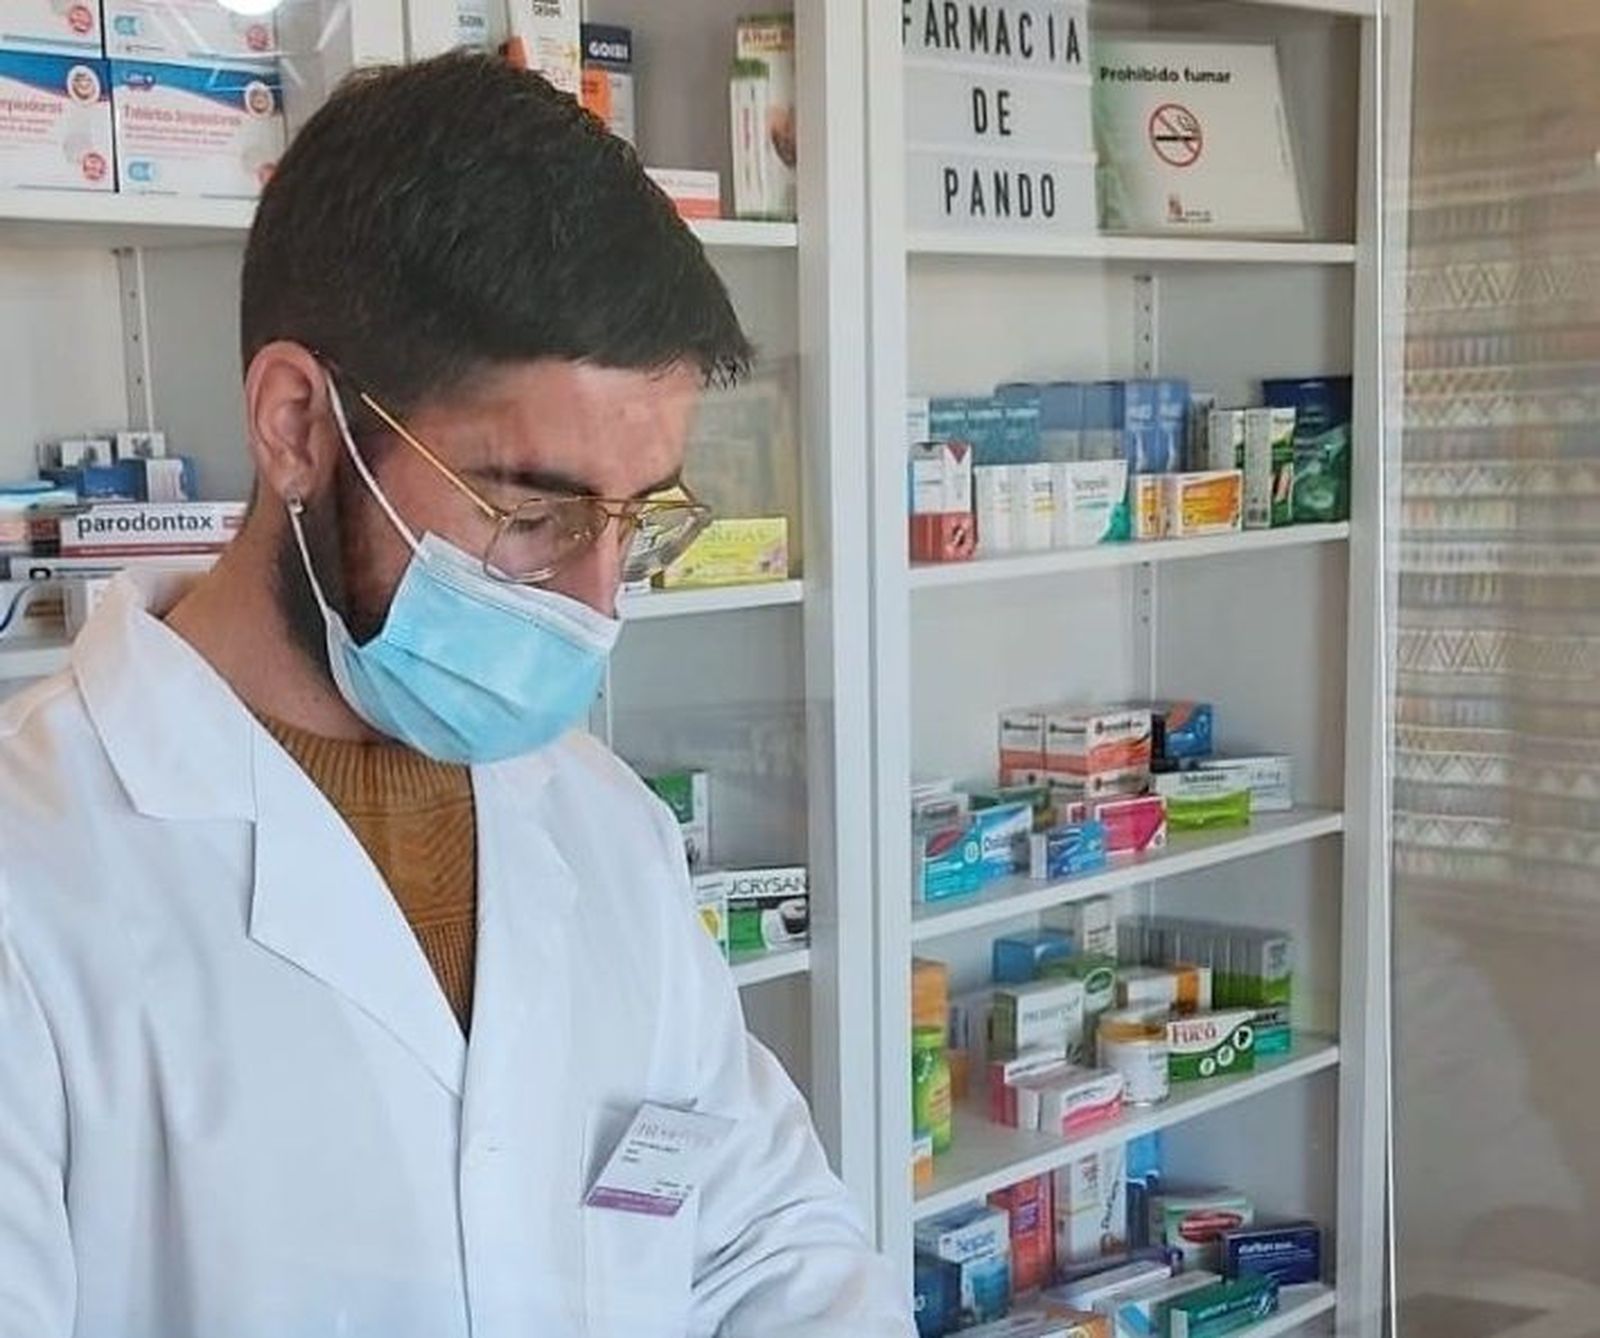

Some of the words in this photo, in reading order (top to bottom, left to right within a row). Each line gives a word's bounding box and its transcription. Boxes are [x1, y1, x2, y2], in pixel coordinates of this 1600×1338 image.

[902, 0, 1081, 64] FARMACIA
[1100, 66, 1180, 83] Prohibido
[1184, 69, 1231, 84] fumar
[973, 87, 1012, 136] DE
[944, 168, 1056, 219] PANDO
[77, 513, 214, 539] parodontax
